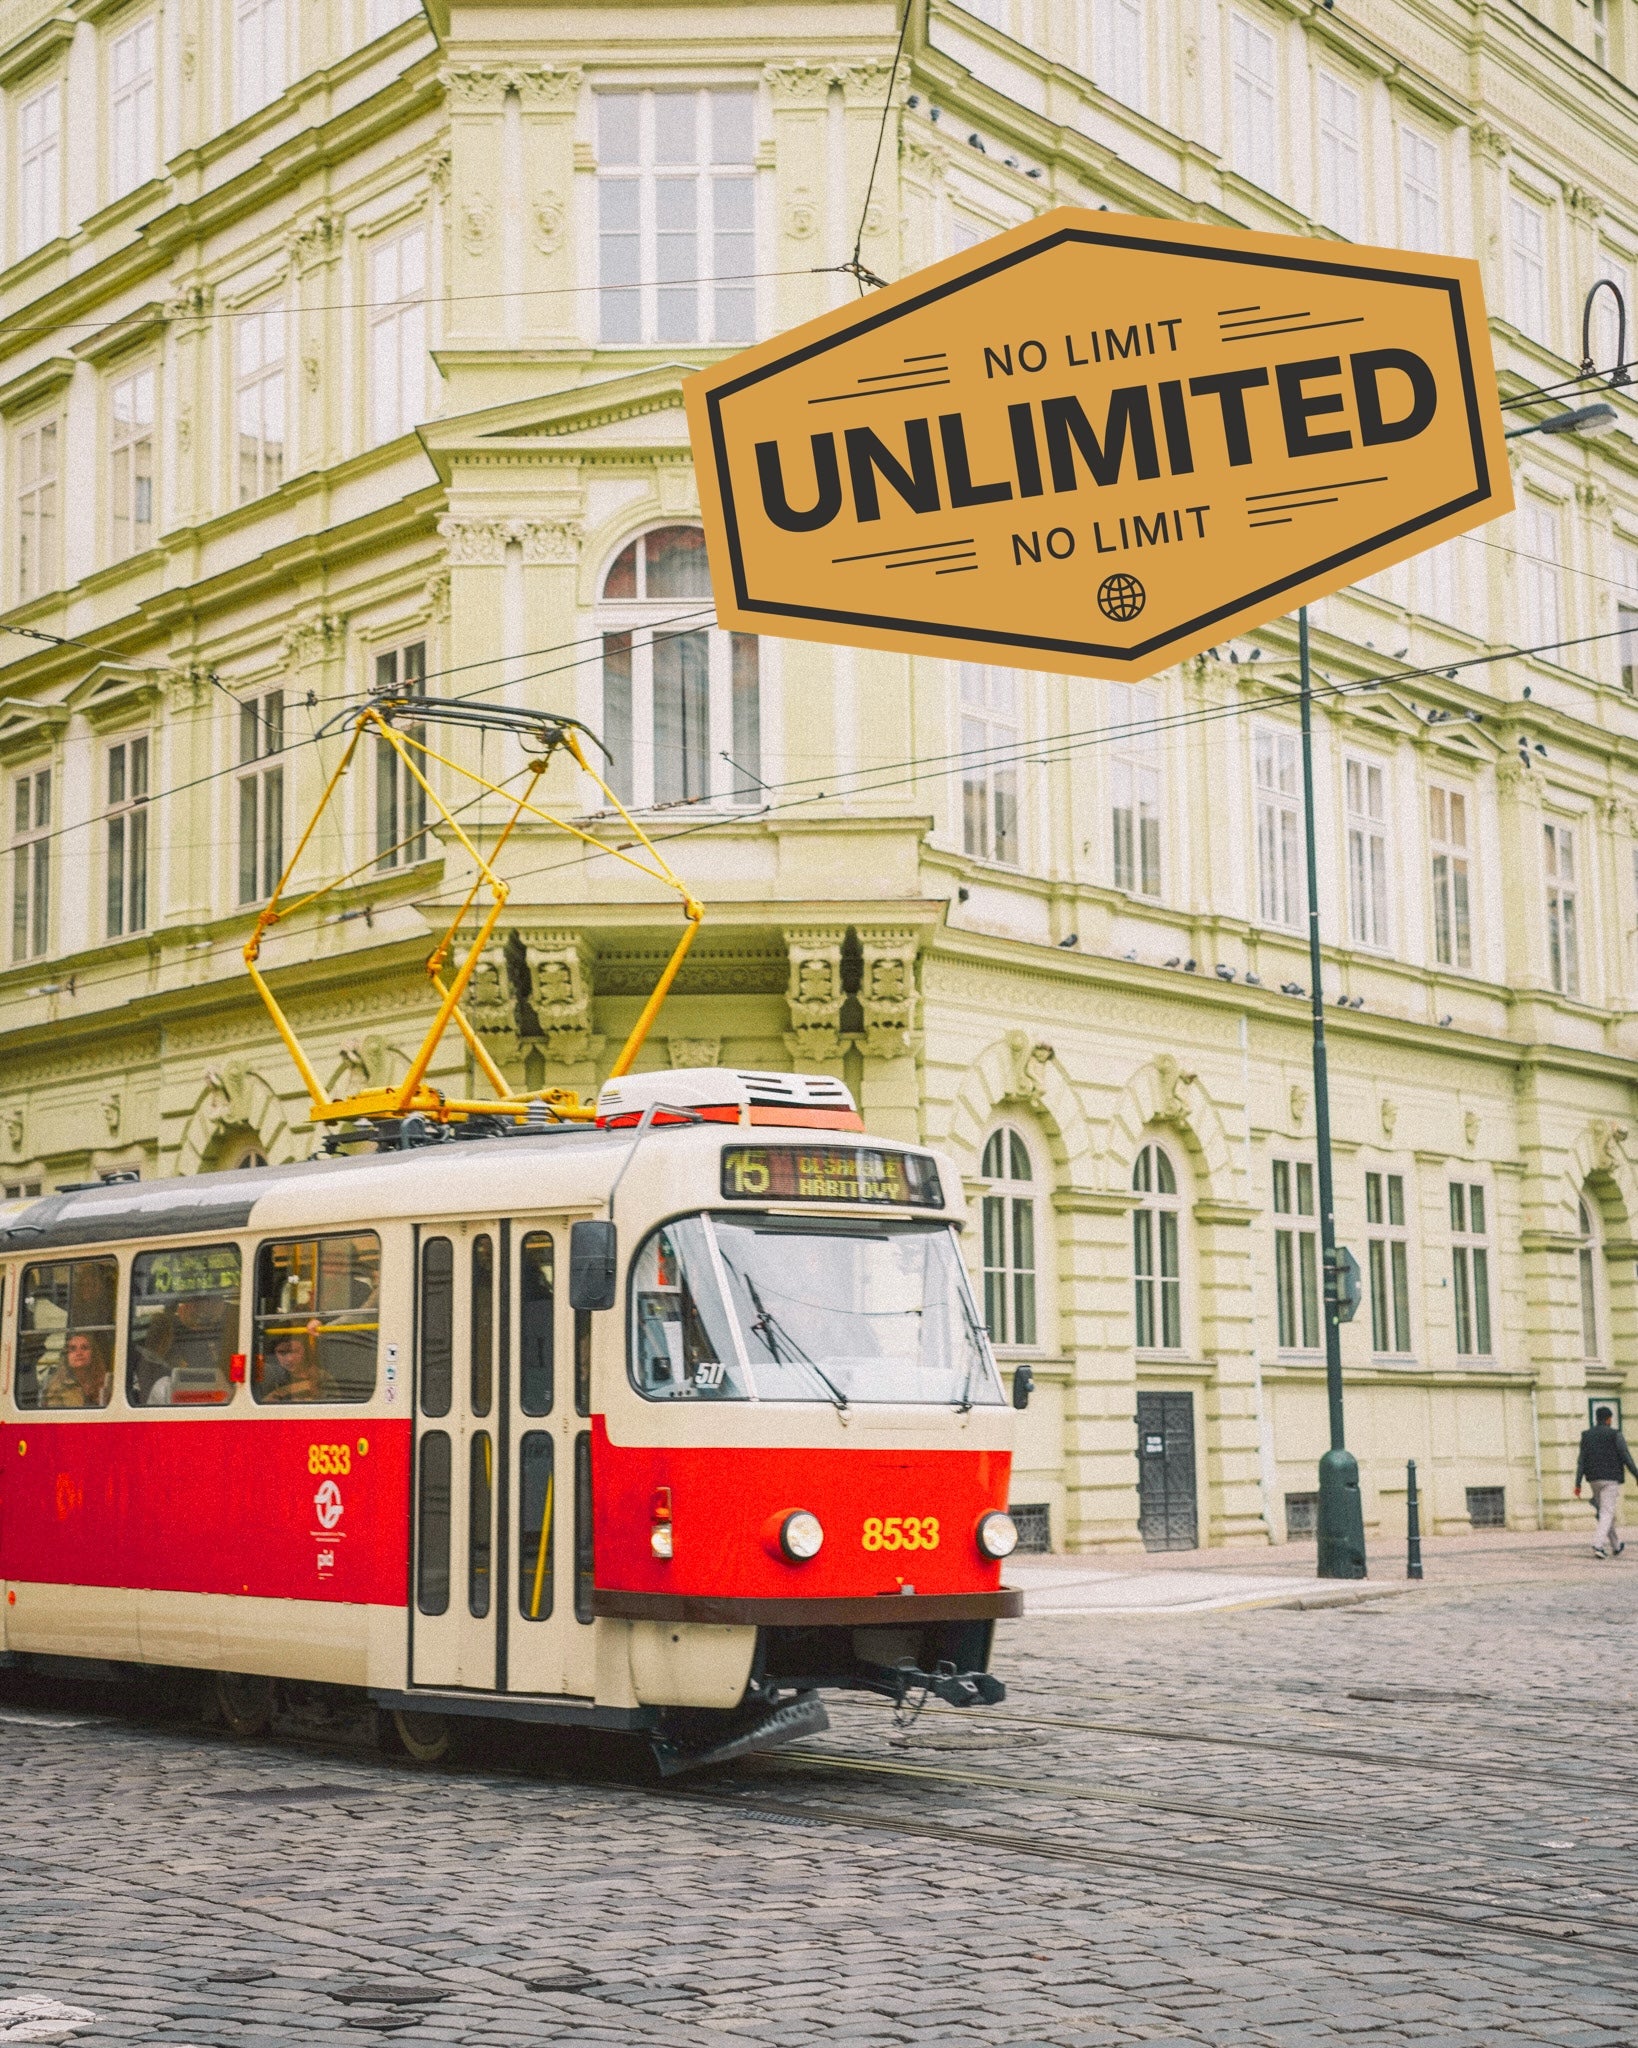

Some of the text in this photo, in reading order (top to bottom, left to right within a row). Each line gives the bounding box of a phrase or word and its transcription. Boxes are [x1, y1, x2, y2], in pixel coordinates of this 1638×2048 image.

[725, 1150, 770, 1194] 15
[694, 1362, 725, 1384] 511
[308, 1443, 351, 1475] 8533
[861, 1516, 940, 1552] 8533
